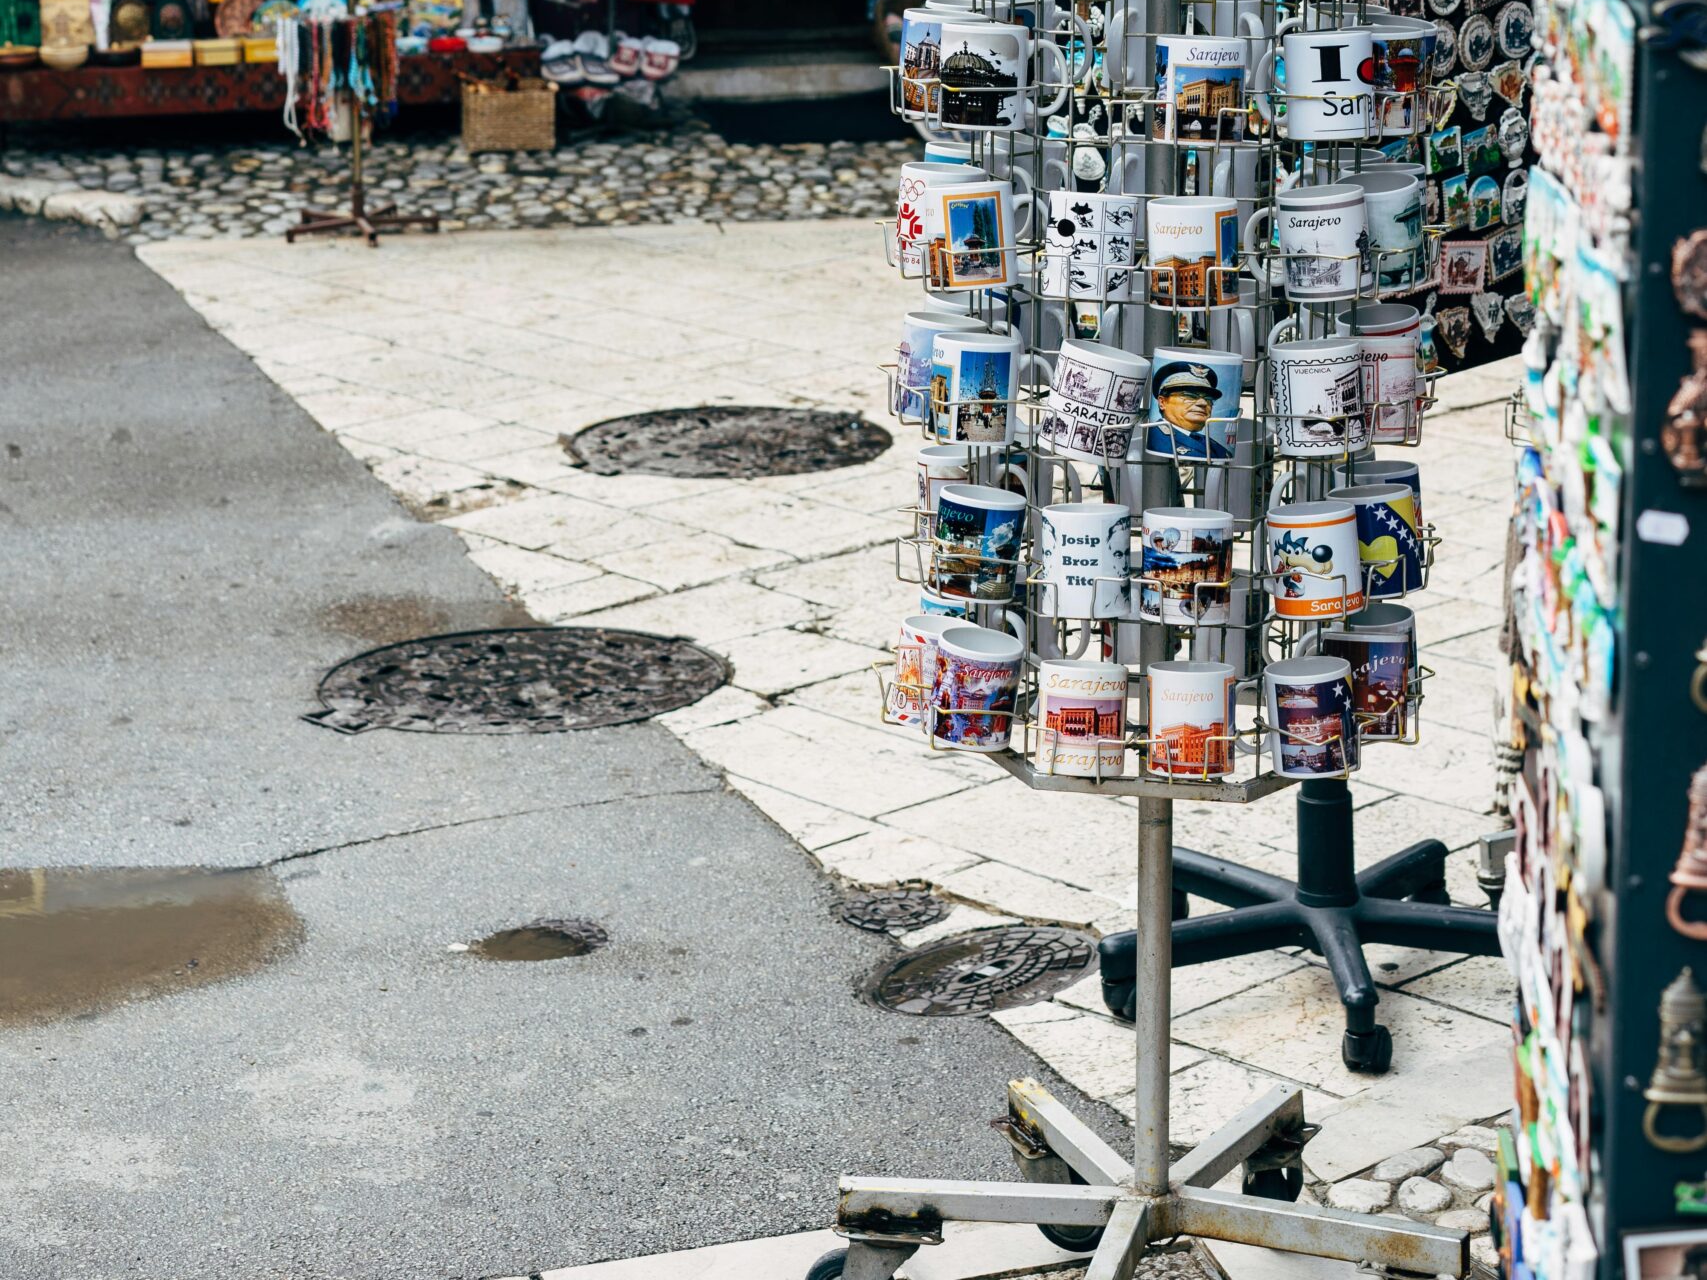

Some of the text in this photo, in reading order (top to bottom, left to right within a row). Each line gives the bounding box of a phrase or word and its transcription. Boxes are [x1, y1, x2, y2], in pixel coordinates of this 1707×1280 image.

[1187, 47, 1239, 65] Sarajevo
[1310, 44, 1351, 83] I
[1153, 222, 1203, 240] Sarajevo
[1288, 216, 1341, 231] Sarajevo
[1063, 402, 1131, 426] SARAJEVO
[1062, 534, 1100, 548] Josip
[1062, 556, 1099, 566] Broz
[1311, 596, 1360, 613] Saraevo
[961, 665, 1012, 683] Sarajevo
[1046, 673, 1126, 696] Sarajevo
[1161, 688, 1214, 705] Sarajevo
[1042, 749, 1122, 771] Sarajevo
